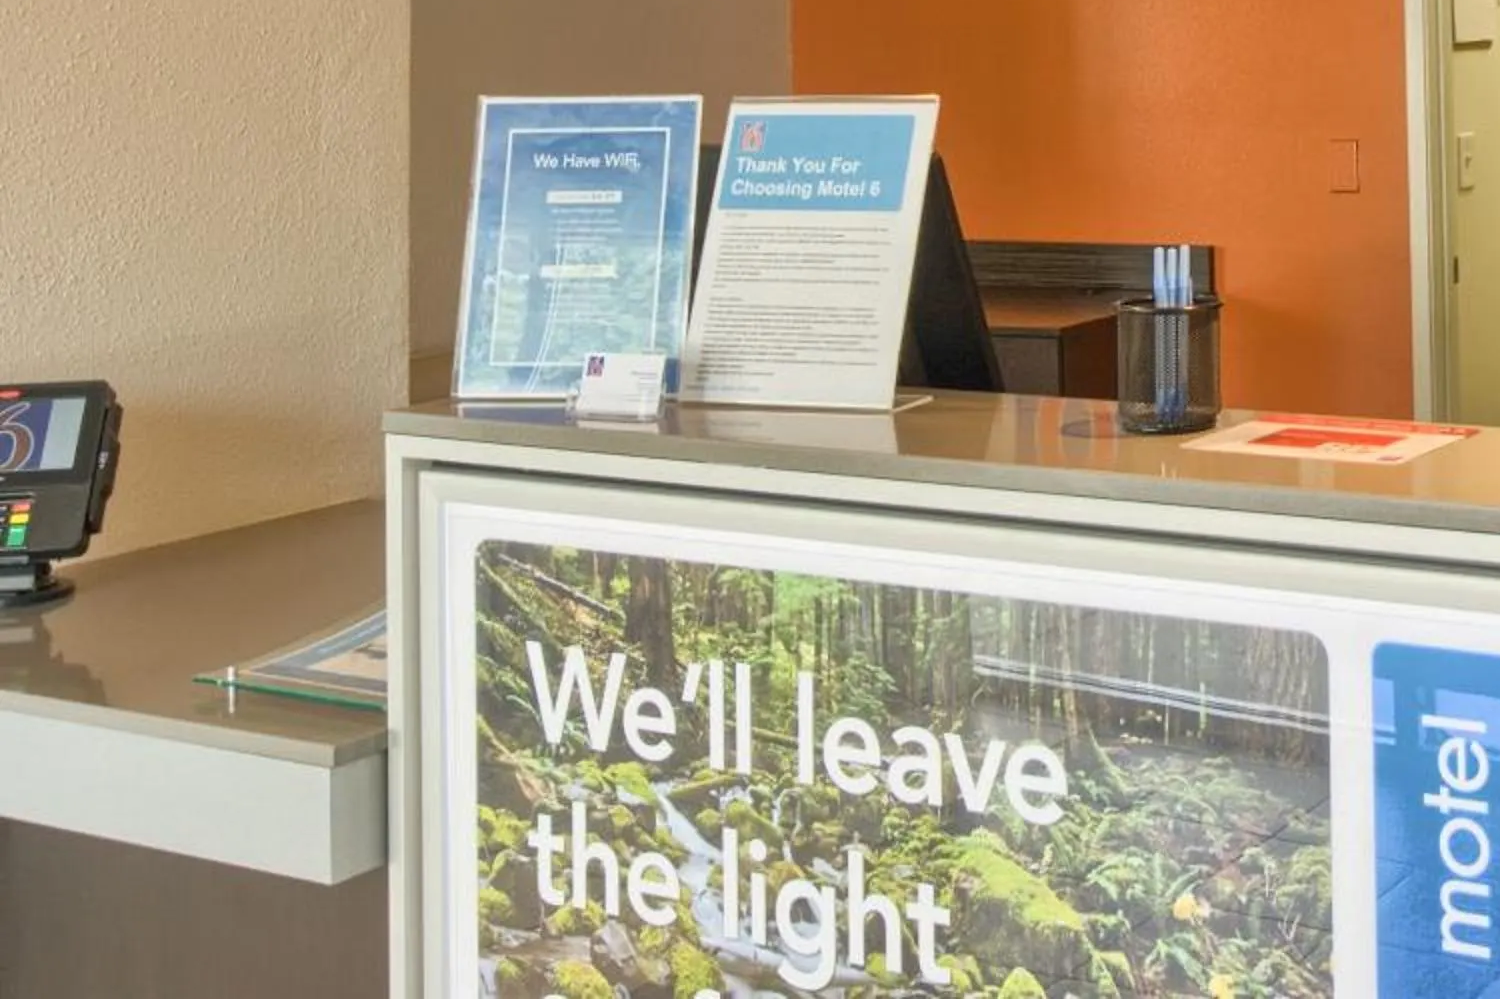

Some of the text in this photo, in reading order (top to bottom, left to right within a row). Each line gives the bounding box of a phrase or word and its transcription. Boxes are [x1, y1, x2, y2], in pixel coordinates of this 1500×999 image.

[533, 153, 558, 168] We
[563, 153, 600, 169] Have
[731, 179, 881, 200] Choosing Motel 6
[736, 156, 861, 174] Thank You For
[525, 639, 1069, 825] We'll leave
[1421, 713, 1493, 962] motel
[527, 801, 951, 991] the light
